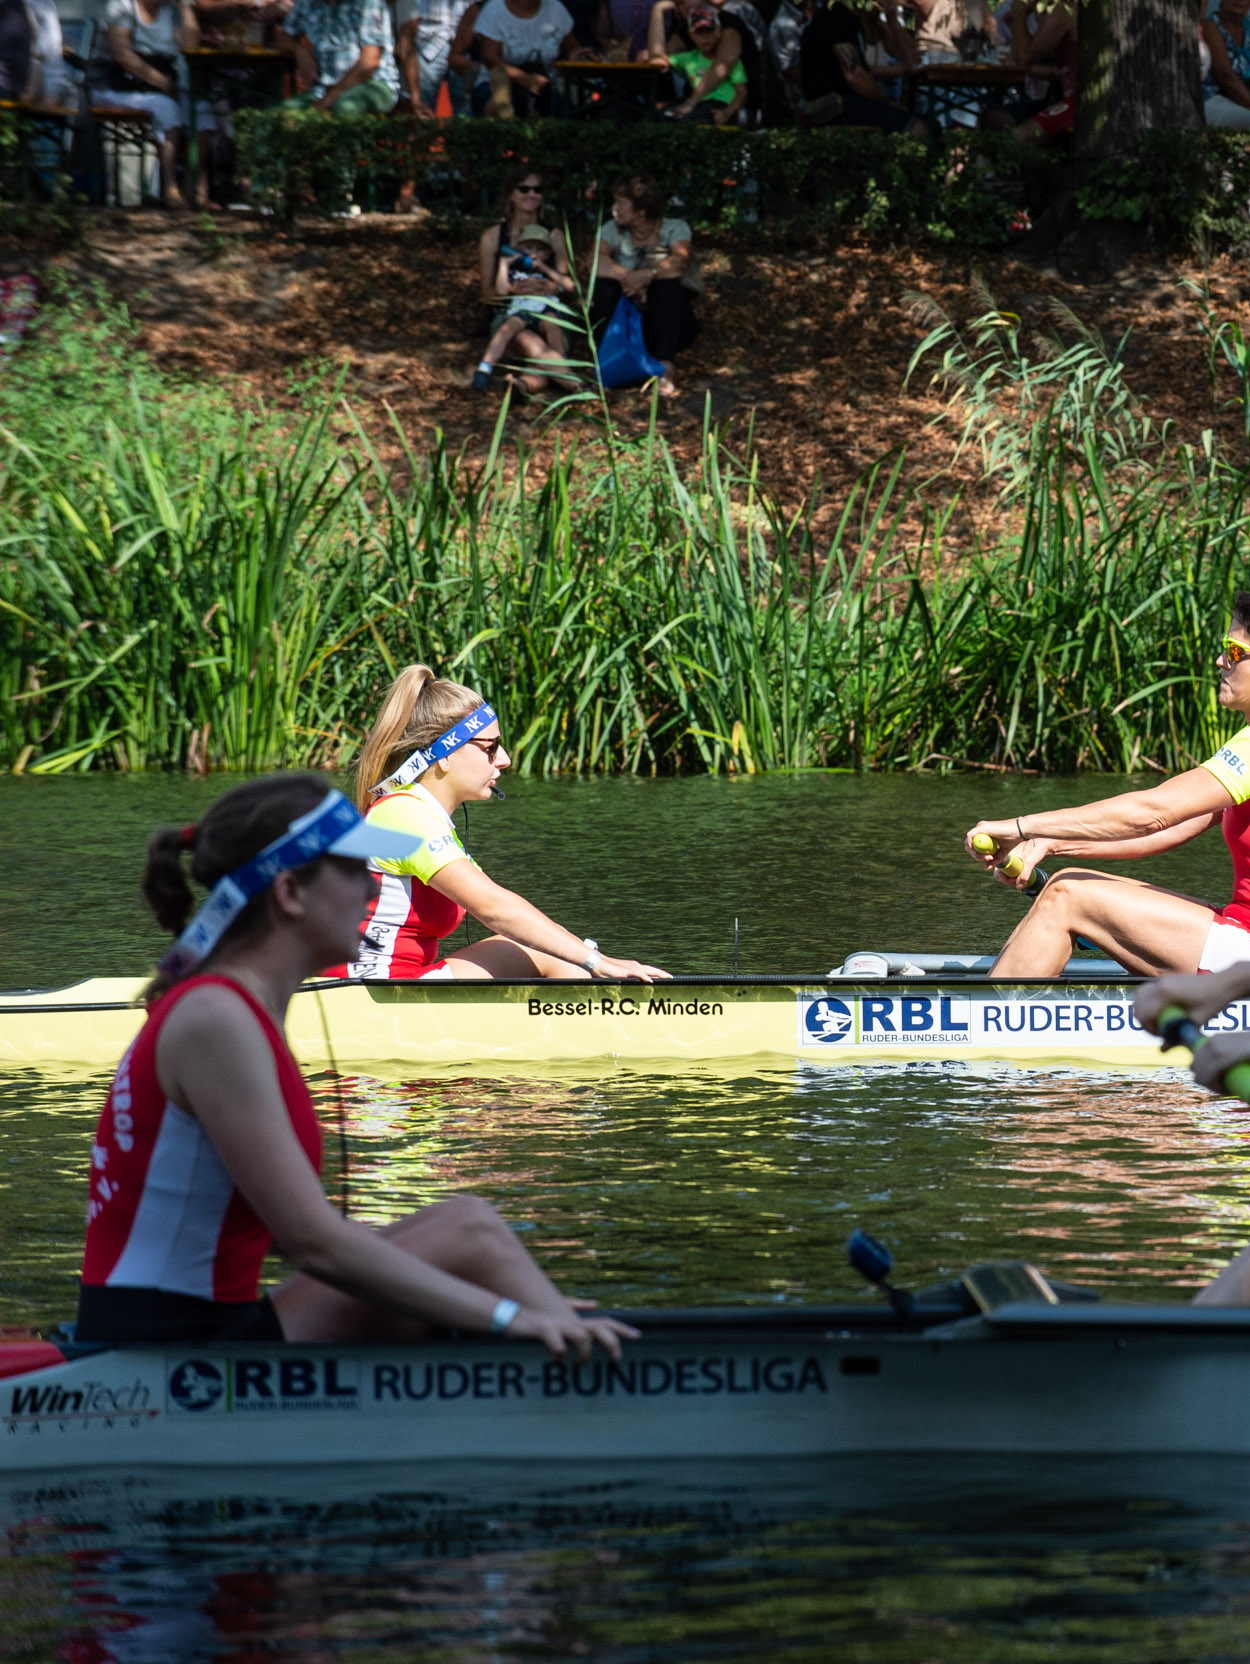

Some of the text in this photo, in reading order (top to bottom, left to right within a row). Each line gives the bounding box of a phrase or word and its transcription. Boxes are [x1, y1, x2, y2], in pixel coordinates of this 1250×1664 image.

[440, 731, 462, 751] NK
[464, 715, 484, 734] NK
[1221, 749, 1245, 775] RBL
[528, 998, 723, 1015] Bessel-R.C. Minden
[862, 996, 969, 1032] RBL
[862, 1034, 969, 1043] RUDER-BUNDESLIGA
[11, 1377, 150, 1414] WinTech
[236, 1358, 359, 1397] RBL
[374, 1355, 828, 1400] RUDER-BUNDESLIGA
